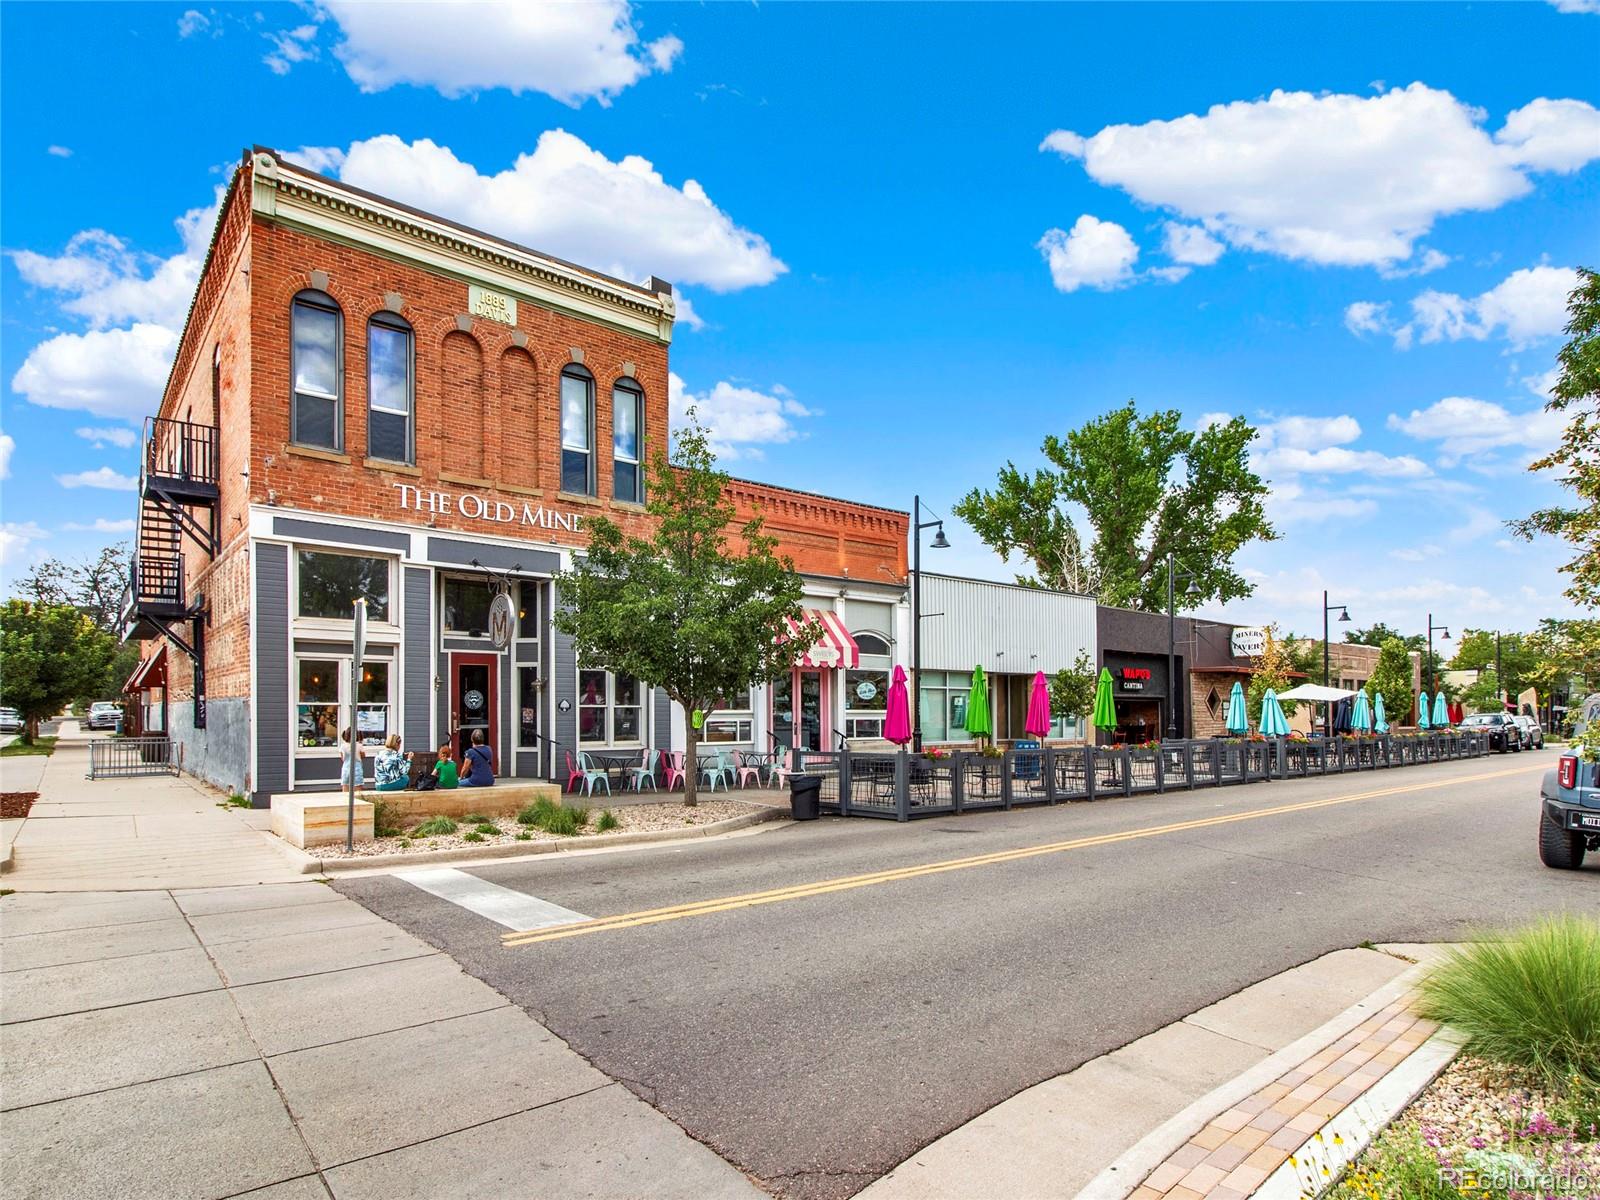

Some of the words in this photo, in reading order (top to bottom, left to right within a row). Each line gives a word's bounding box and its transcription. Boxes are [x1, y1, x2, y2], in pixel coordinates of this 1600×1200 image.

[480, 291, 505, 310] 1889
[475, 302, 512, 322] DAVIS
[393, 483, 451, 514] THE
[459, 494, 515, 523] OLD
[521, 503, 584, 533] MINE
